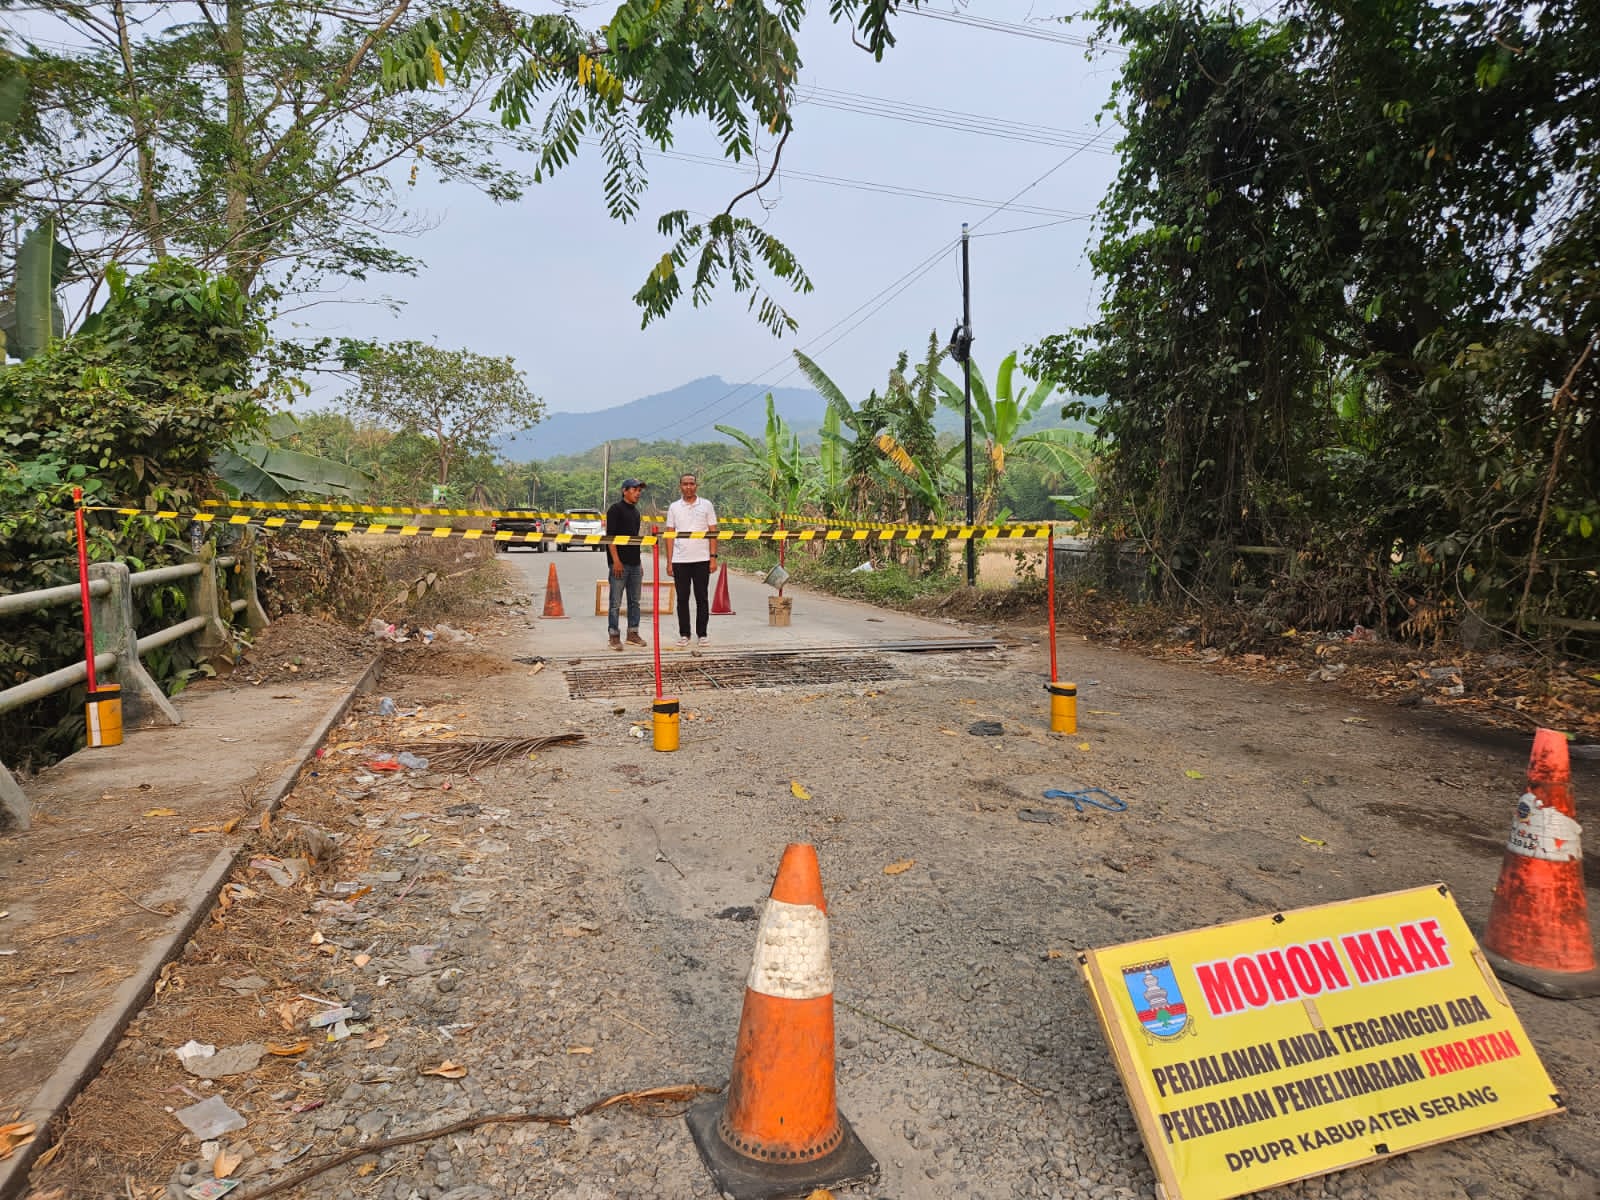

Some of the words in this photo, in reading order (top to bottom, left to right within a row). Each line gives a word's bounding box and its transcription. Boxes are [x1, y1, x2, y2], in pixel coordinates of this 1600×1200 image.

[1194, 939, 1351, 1017] MOHON
[1340, 918, 1452, 985] MAAF
[1152, 1042, 1281, 1097] PERJALANAN
[1278, 1030, 1340, 1067] ANDA
[1333, 1004, 1449, 1052] TERGANGGU
[1446, 995, 1491, 1027] ADA
[1159, 1089, 1277, 1144] PEKERJAAN
[1272, 1053, 1425, 1114] PEMELIHARAAN
[1420, 1030, 1521, 1078] JEMBATAN
[1225, 1138, 1298, 1172] DPUPR
[1297, 1106, 1421, 1152] KABUPATEN
[1420, 1086, 1499, 1119] SERANG
